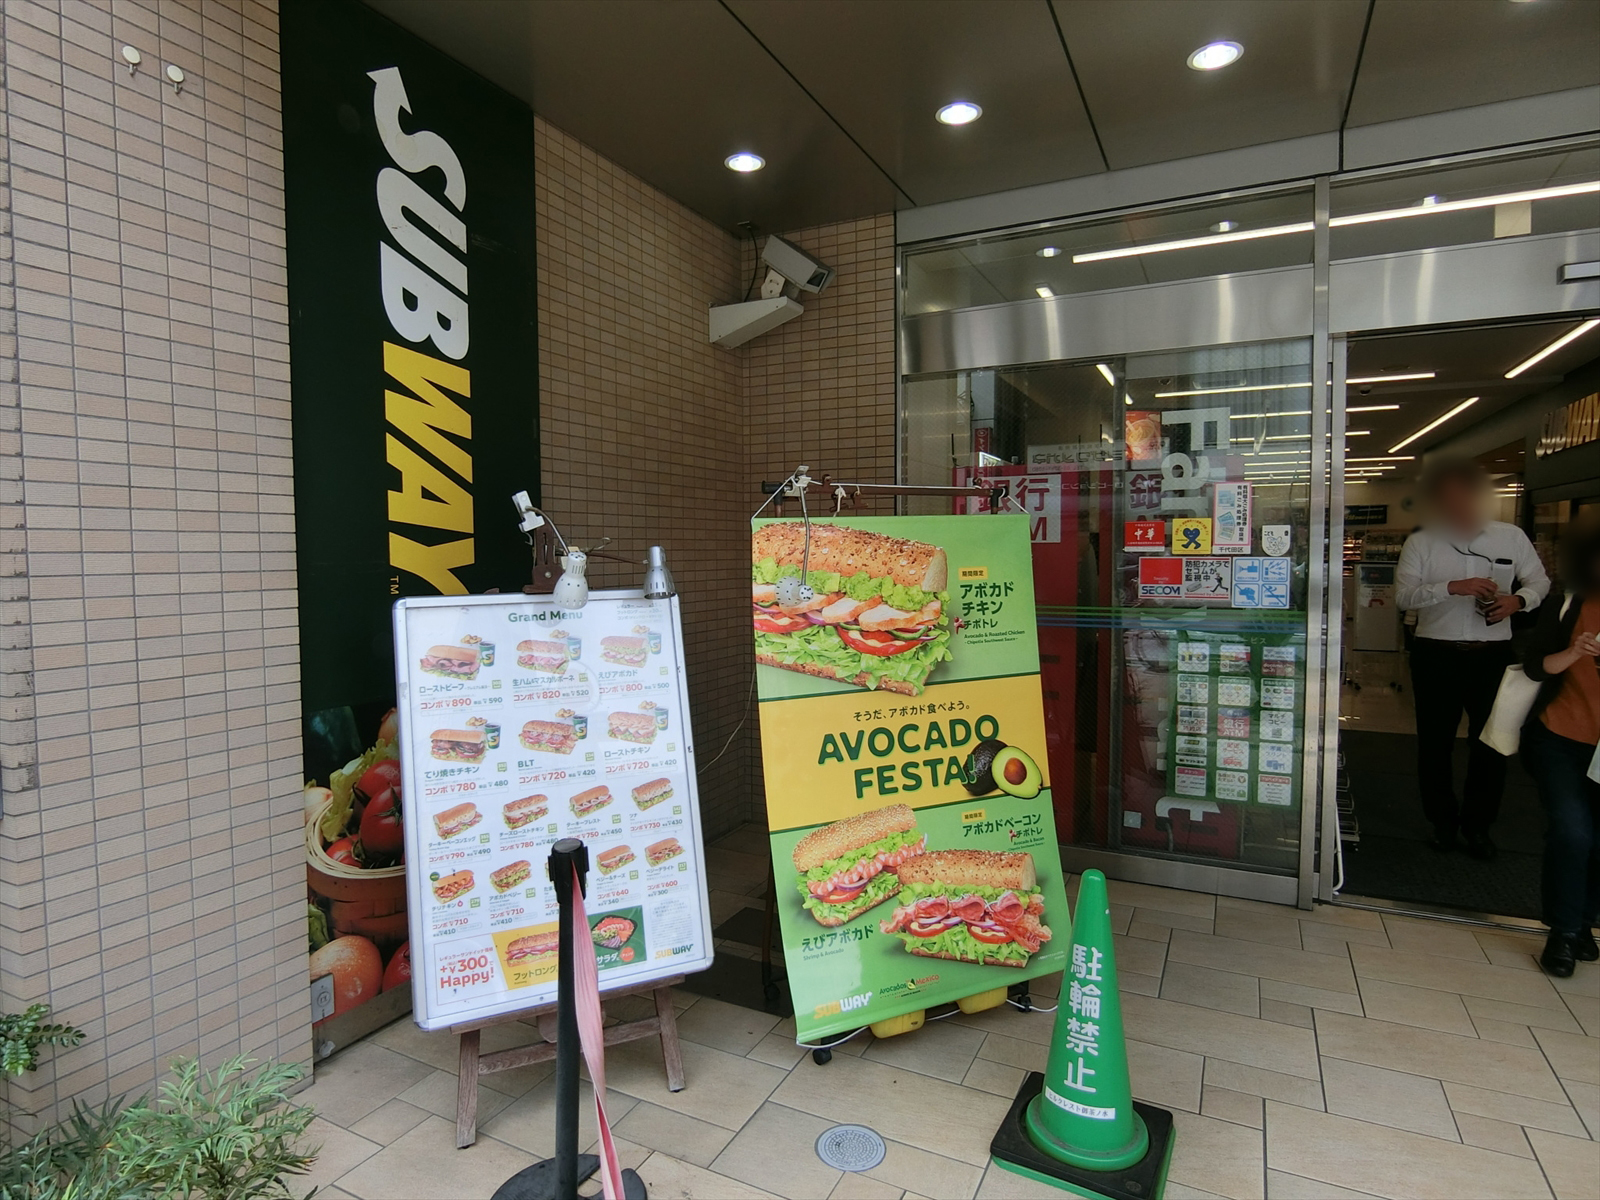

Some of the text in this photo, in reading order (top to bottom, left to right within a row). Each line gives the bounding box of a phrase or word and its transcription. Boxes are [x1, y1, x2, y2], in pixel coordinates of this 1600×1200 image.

[366, 66, 475, 595] SUBWAY
[390, 575, 399, 595] TM
[960, 581, 1014, 600] アボカド
[1142, 586, 1180, 595] SECOM
[962, 600, 1003, 616] チキン
[508, 610, 583, 622] Grand Menu
[598, 670, 638, 679] えびアボカド
[420, 684, 464, 694] ローストビーフ
[514, 693, 534, 701] コンボ
[420, 700, 443, 710] コンボ
[853, 701, 970, 722] そうだ、アボカド食べよう。
[818, 714, 999, 764] AVOCADO
[604, 746, 650, 757] ローストチキン
[518, 760, 534, 768] BLT
[424, 766, 480, 778] てり焼きチキン
[519, 774, 540, 784] コンボ
[854, 754, 978, 799] FESTA!
[425, 786, 448, 795] コンボ
[963, 814, 1041, 837] アボカドベーコン
[802, 924, 874, 952] えびアボカド
[596, 952, 618, 963] サラダ
[655, 944, 694, 959] SUBWAY
[825, 948, 844, 957] Avocado
[440, 967, 494, 989] Happy!
[514, 965, 557, 981] フットロング
[813, 991, 873, 1019] SUBWAY
[1064, 944, 1103, 1093] 駐輪禁止
